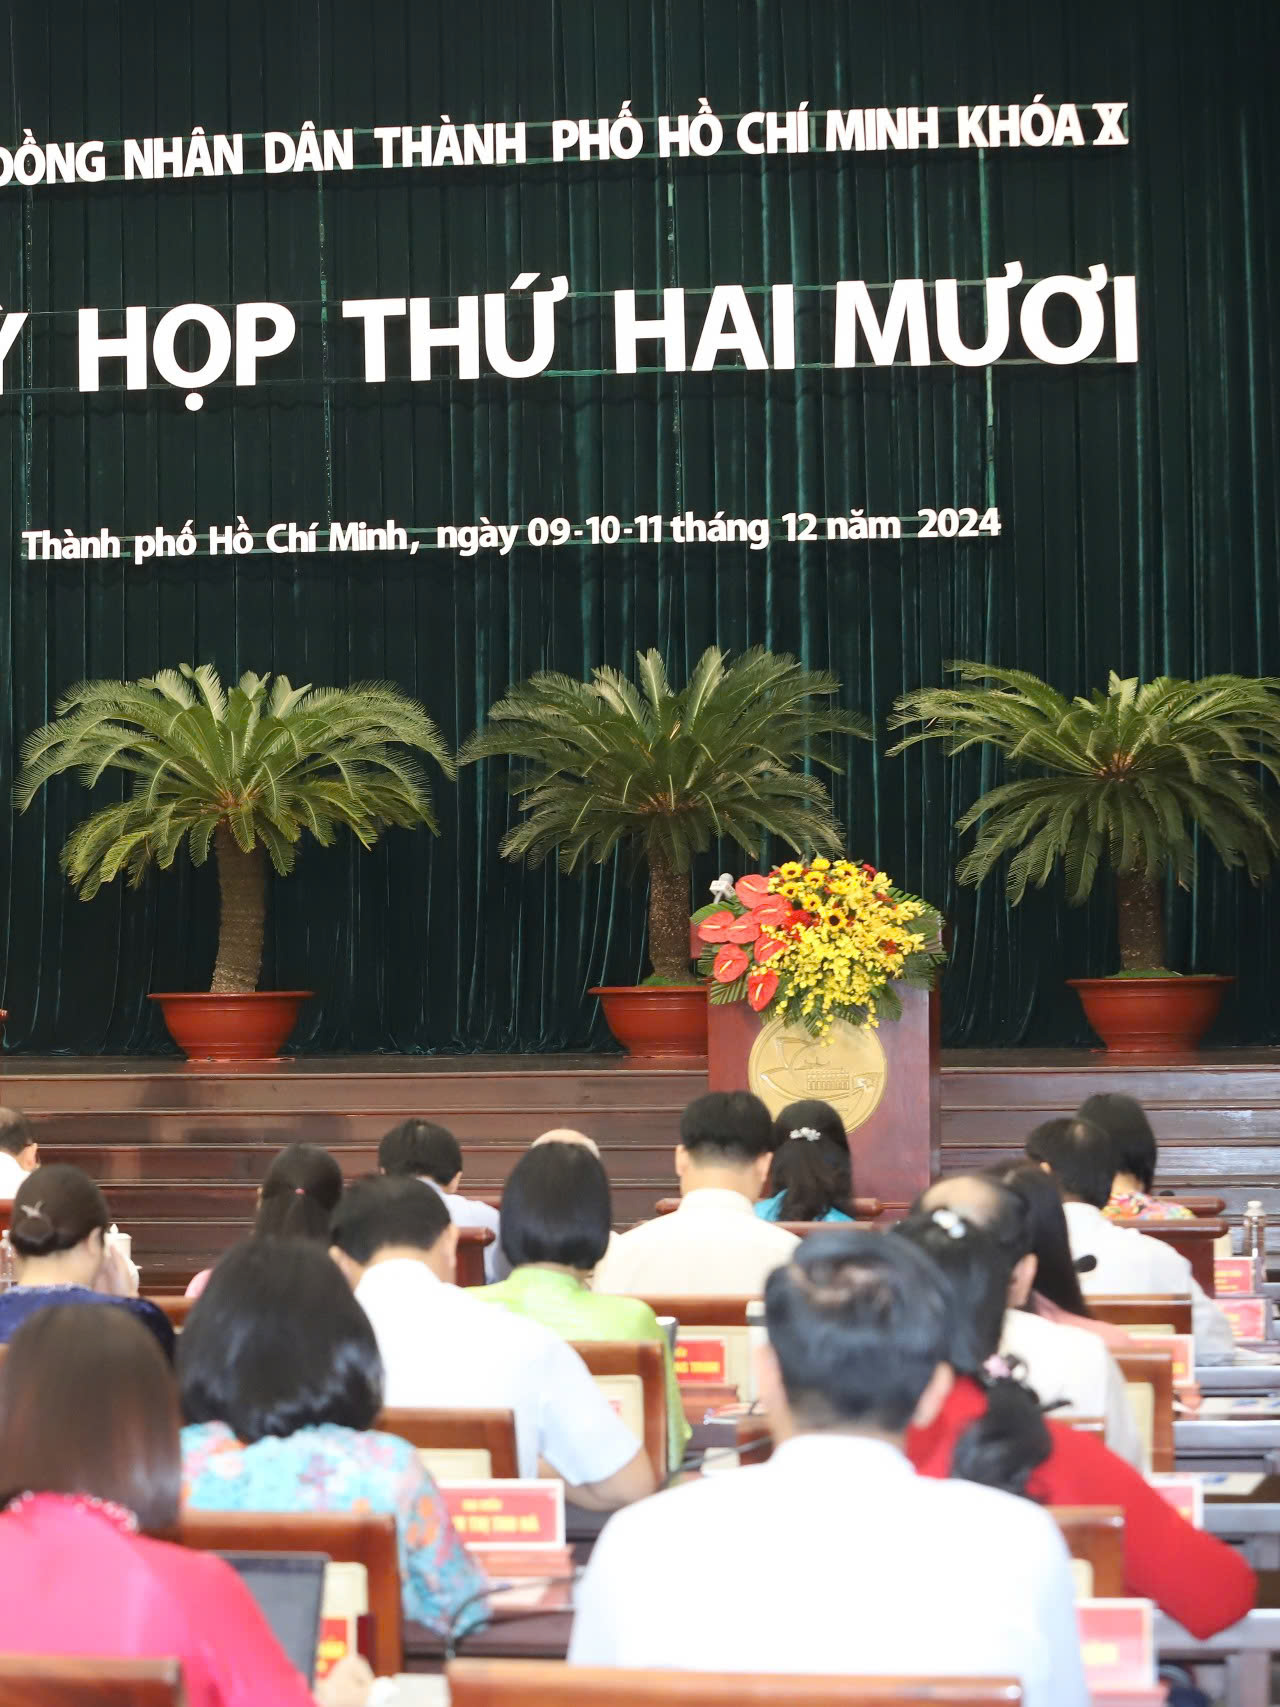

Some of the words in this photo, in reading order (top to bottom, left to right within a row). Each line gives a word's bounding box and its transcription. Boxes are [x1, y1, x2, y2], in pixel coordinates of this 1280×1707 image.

[123, 126, 244, 181] NHÂN
[264, 120, 354, 174] DÂN
[373, 114, 527, 169] THÀNH
[551, 100, 644, 163] PHỐ
[657, 97, 724, 158] HỒ
[736, 100, 809, 155] CHÍ
[825, 106, 940, 152] MINH
[957, 93, 1085, 149] KHÓA
[1091, 102, 1129, 146] X
[78, 302, 296, 412] HỌP
[341, 272, 569, 383] THỨ
[613, 283, 796, 374] HAI
[834, 260, 1139, 369] MƯƠI
[21, 527, 121, 561] Thành
[134, 519, 197, 565] phố
[209, 515, 254, 556] Hồ
[265, 521, 320, 554] Chí
[328, 519, 420, 555] Minh,
[436, 516, 520, 557] ngày
[669, 510, 770, 551] tháng
[781, 512, 818, 542] 12
[826, 508, 902, 540] năm
[917, 507, 1002, 538] 2024
